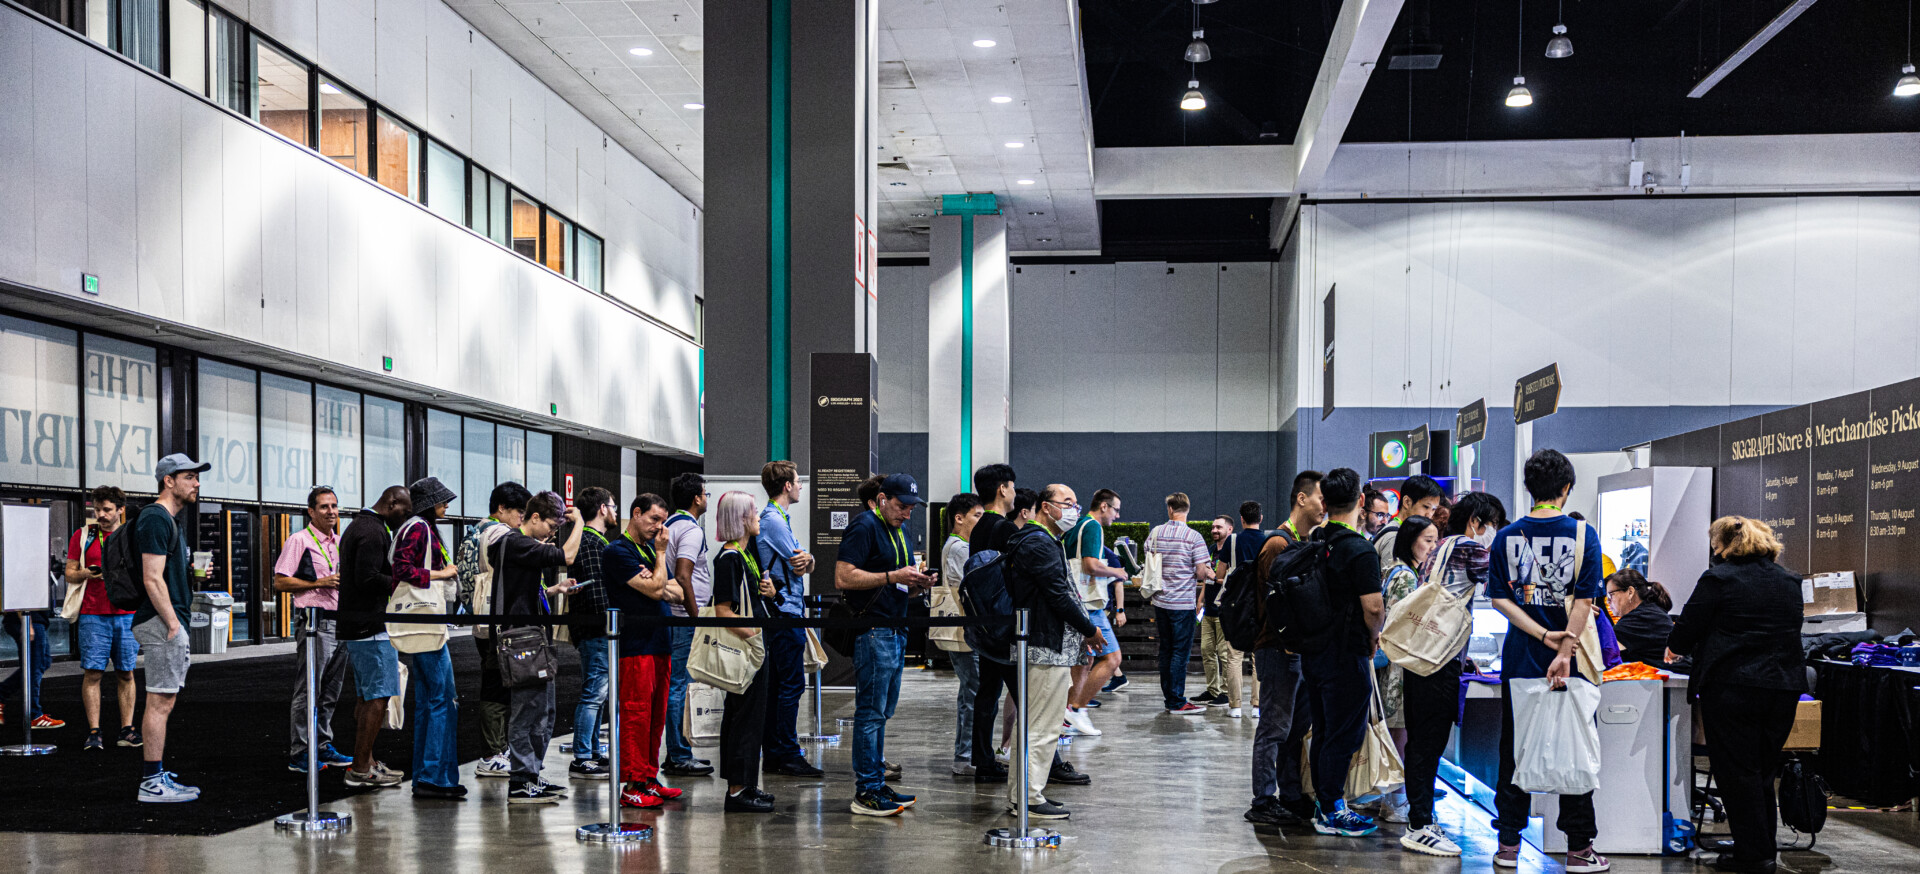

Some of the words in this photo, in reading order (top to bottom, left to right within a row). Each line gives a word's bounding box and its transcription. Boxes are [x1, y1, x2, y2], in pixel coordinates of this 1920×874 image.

[1732, 433, 1775, 461] SIGGRAPH
[1776, 430, 1803, 454] Store
[1805, 426, 1812, 449] &
[1815, 411, 1889, 447] Merchandise
[1871, 463, 1898, 475] Wednesday,
[1898, 460, 1901, 471] 9
[1902, 459, 1920, 473] August
[1816, 470, 1835, 481] Monday,
[1838, 468, 1854, 481] August
[1831, 485, 1838, 495] pm
[1871, 480, 1875, 490] 8
[1888, 479, 1894, 490] pm
[1816, 514, 1833, 525] Tuesday,
[1839, 513, 1854, 525] August
[1870, 510, 1890, 521] Thursday,
[1891, 509, 1897, 519] 10
[1898, 508, 1915, 521] August
[1832, 529, 1838, 539] pm
[1898, 526, 1906, 537] pm
